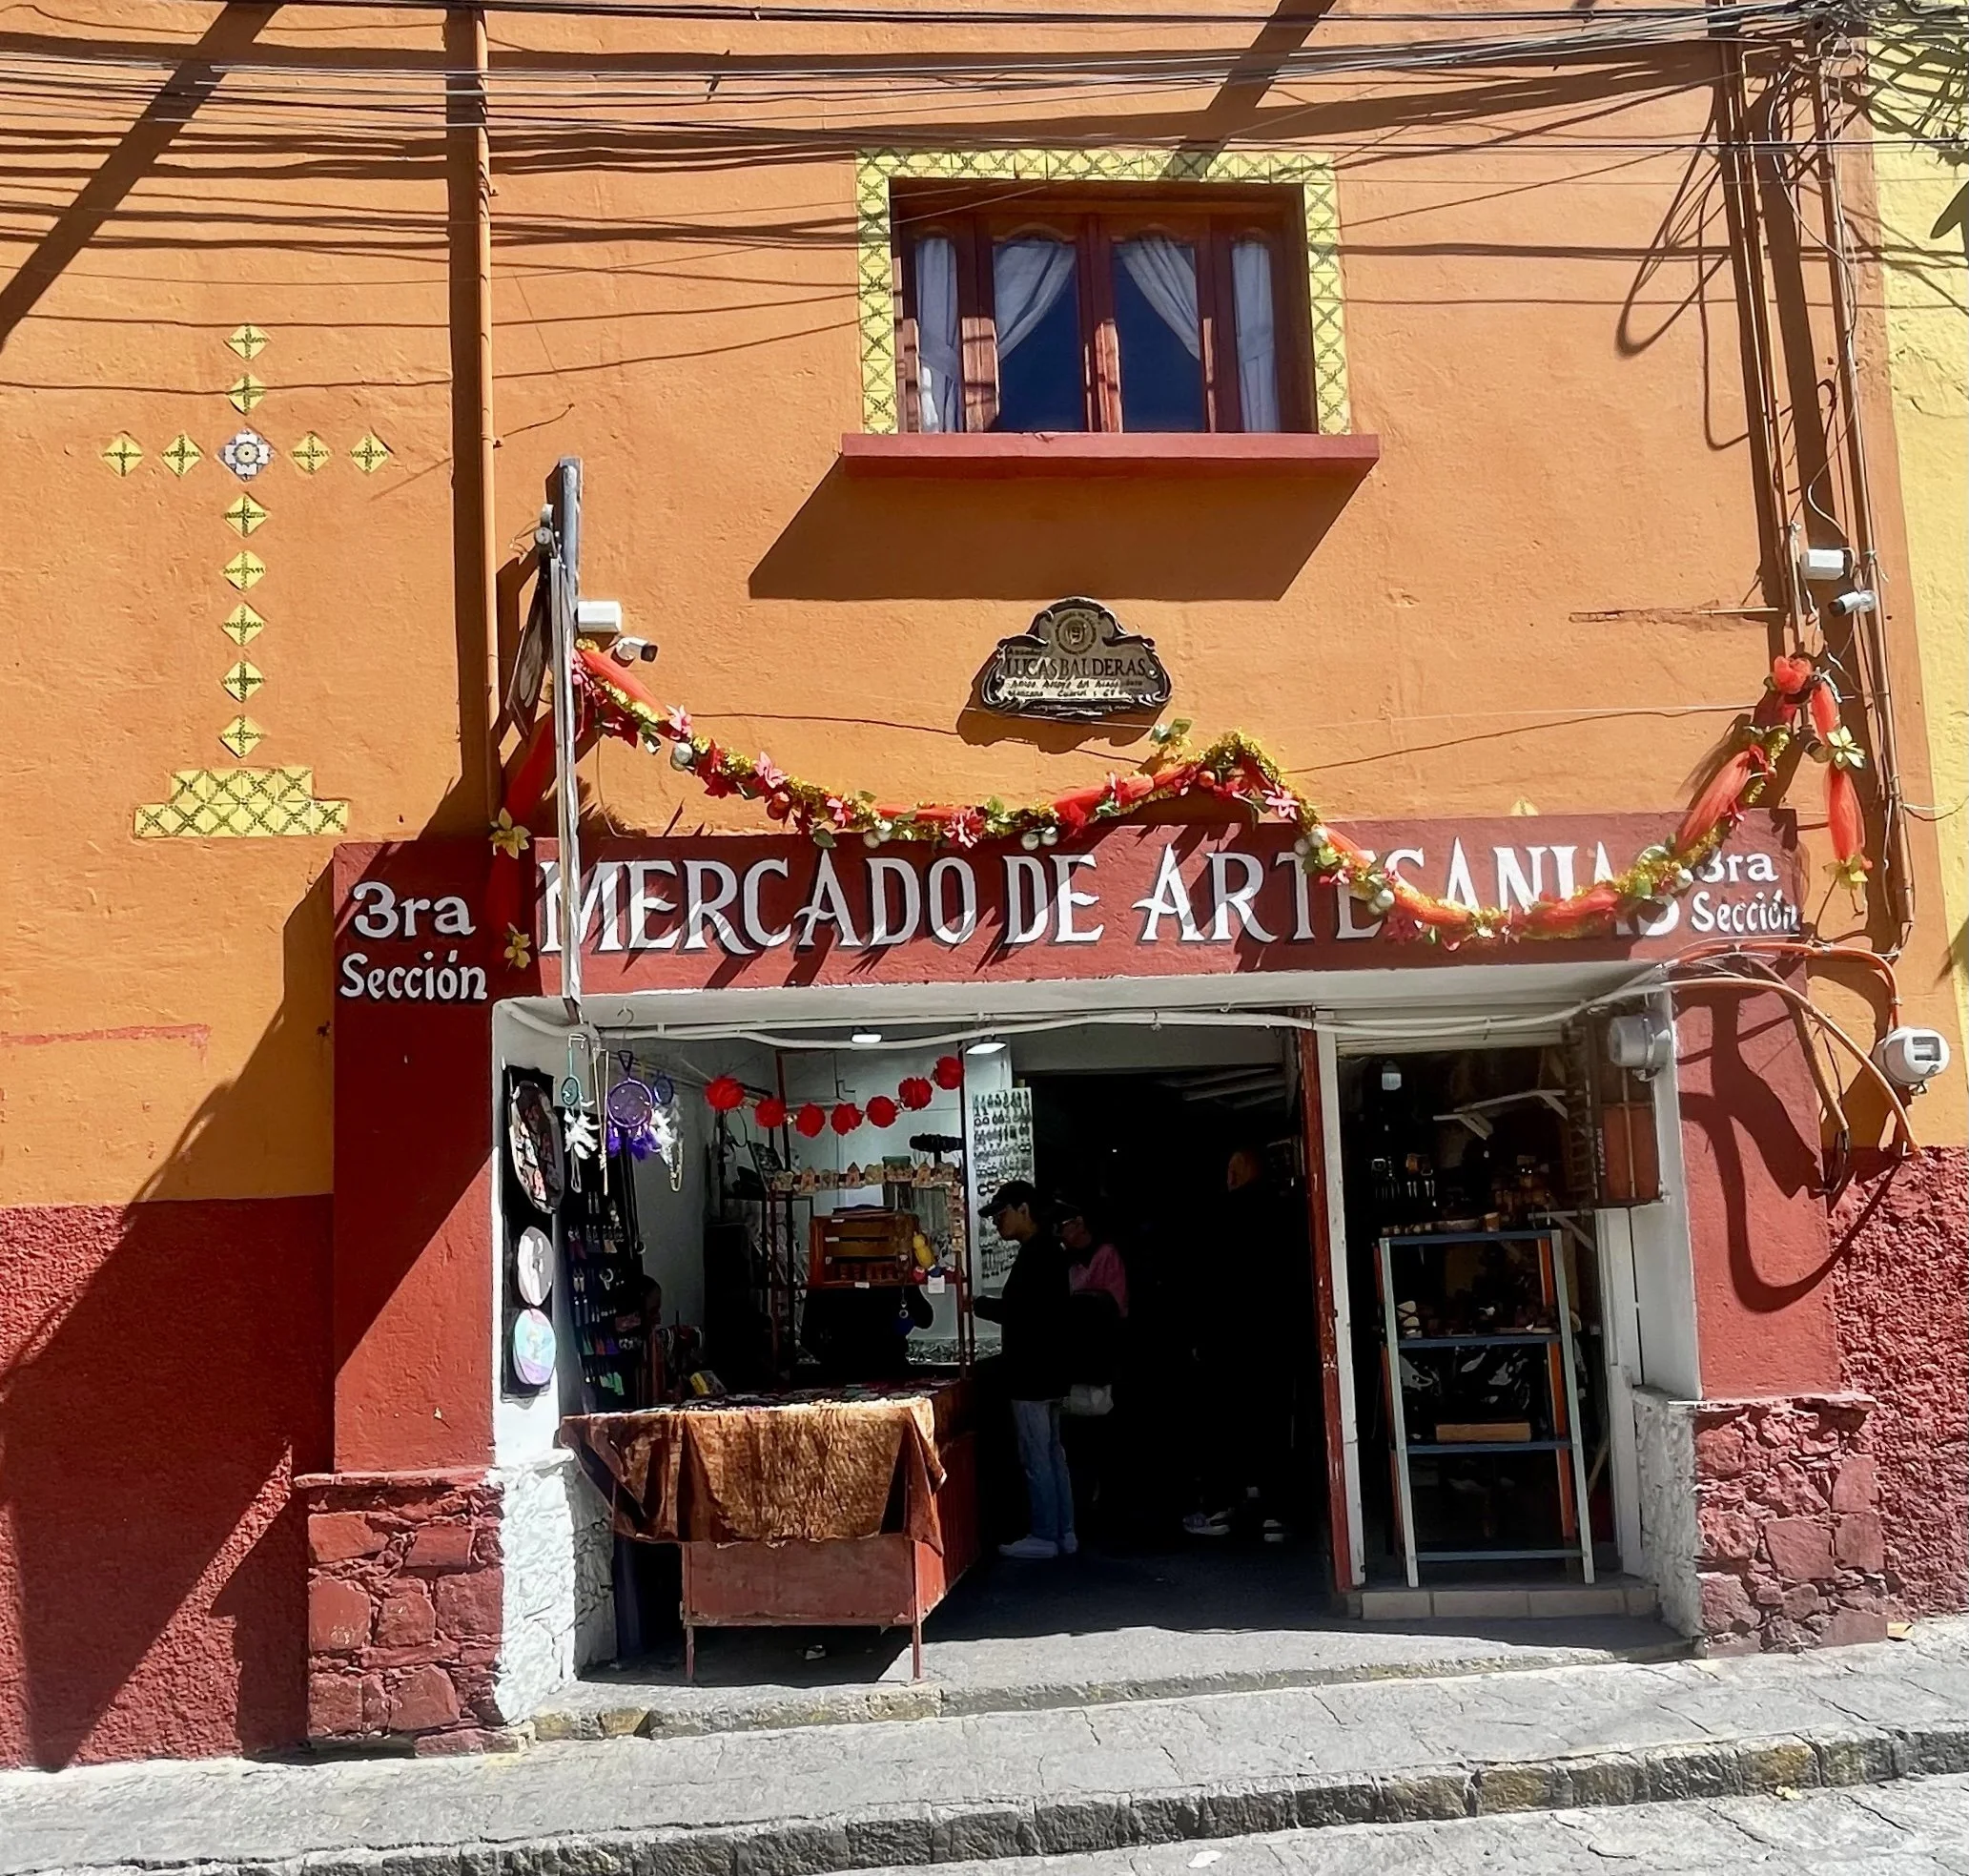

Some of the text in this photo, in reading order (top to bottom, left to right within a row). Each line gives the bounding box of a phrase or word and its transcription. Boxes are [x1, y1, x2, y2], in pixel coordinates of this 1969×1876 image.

[1007, 657, 1146, 676] LUCAS BALDERAS
[1697, 846, 1779, 883] 3ra
[354, 881, 476, 938] 3ra
[539, 849, 977, 955] MERCADO
[1002, 855, 1105, 944] DE
[1691, 889, 1800, 933] Sección
[339, 950, 487, 1000] Sección
